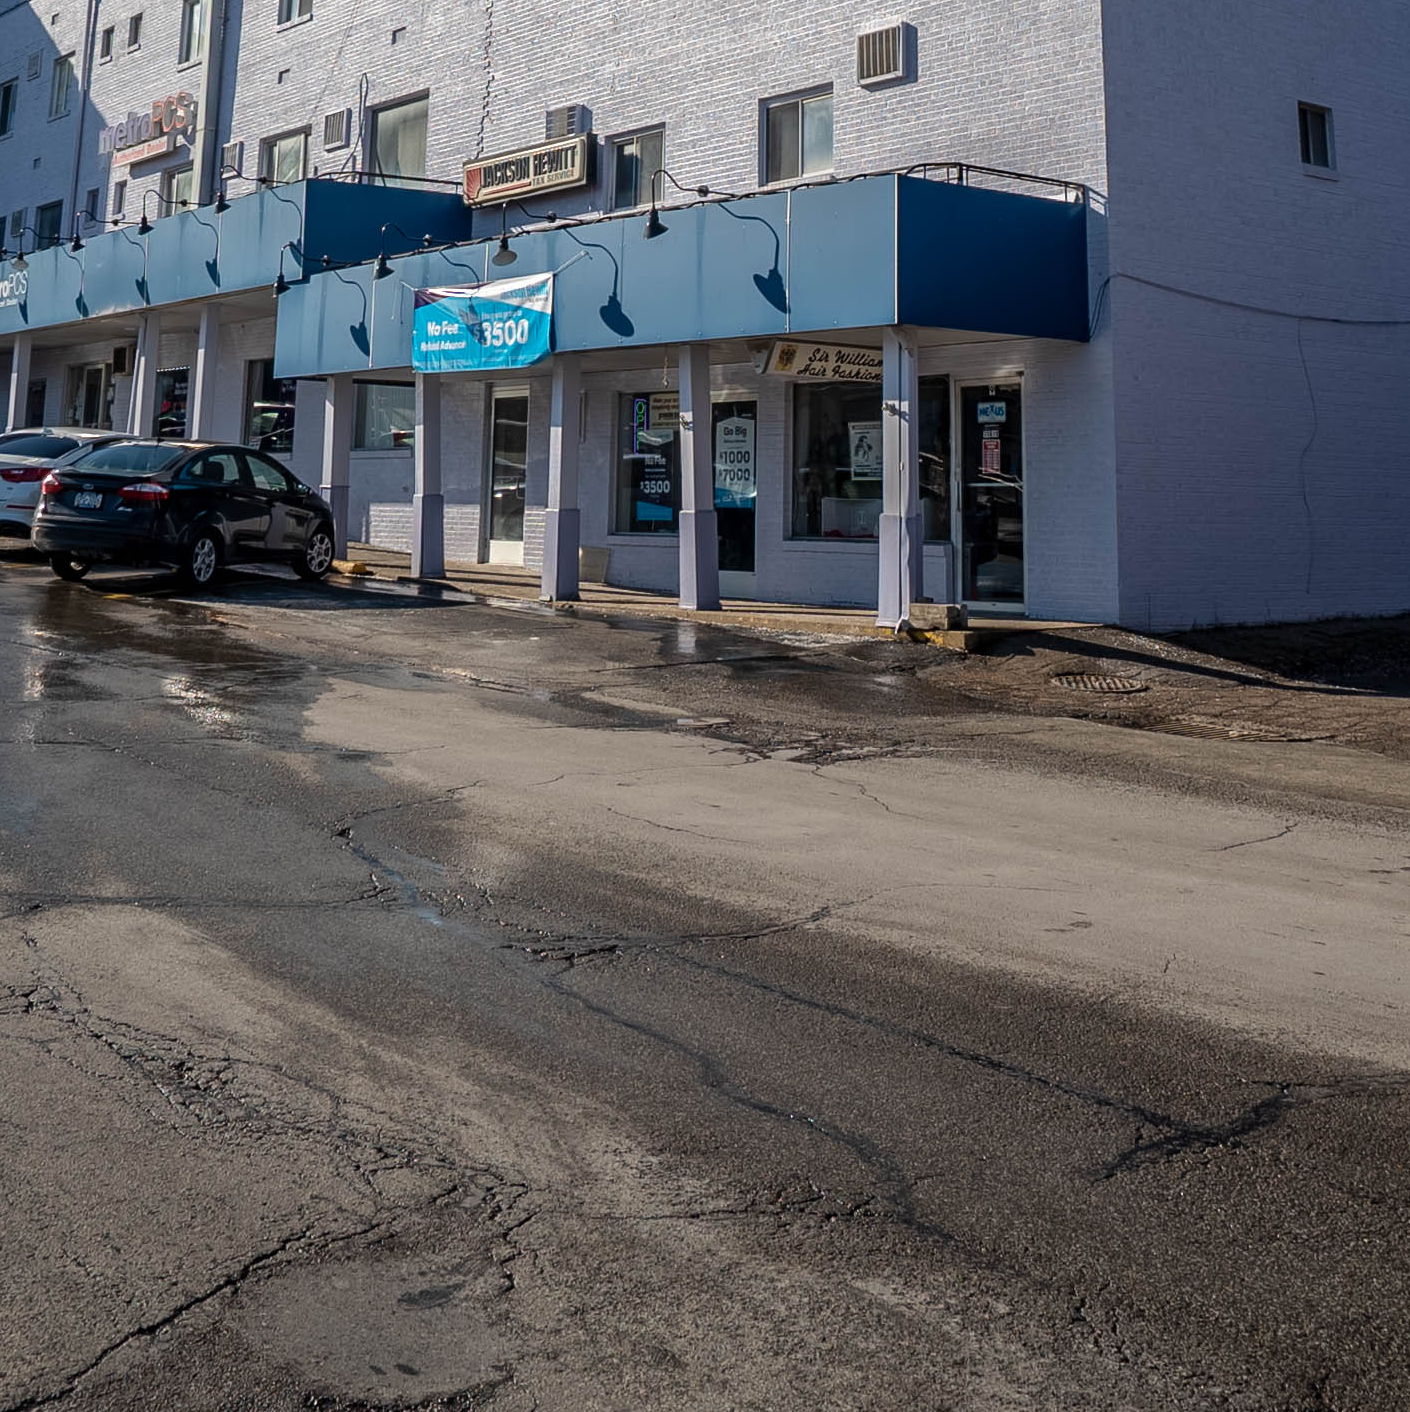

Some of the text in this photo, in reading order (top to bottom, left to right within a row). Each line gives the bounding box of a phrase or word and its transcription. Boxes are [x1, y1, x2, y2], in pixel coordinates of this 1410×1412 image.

[481, 145, 577, 188] JACKSON HEWITT
[532, 169, 575, 186] TAX SERVICE
[427, 320, 459, 336] No Fee
[808, 348, 829, 363] Sir
[797, 364, 883, 380] Hair Fashion
[723, 425, 747, 438] Go Big
